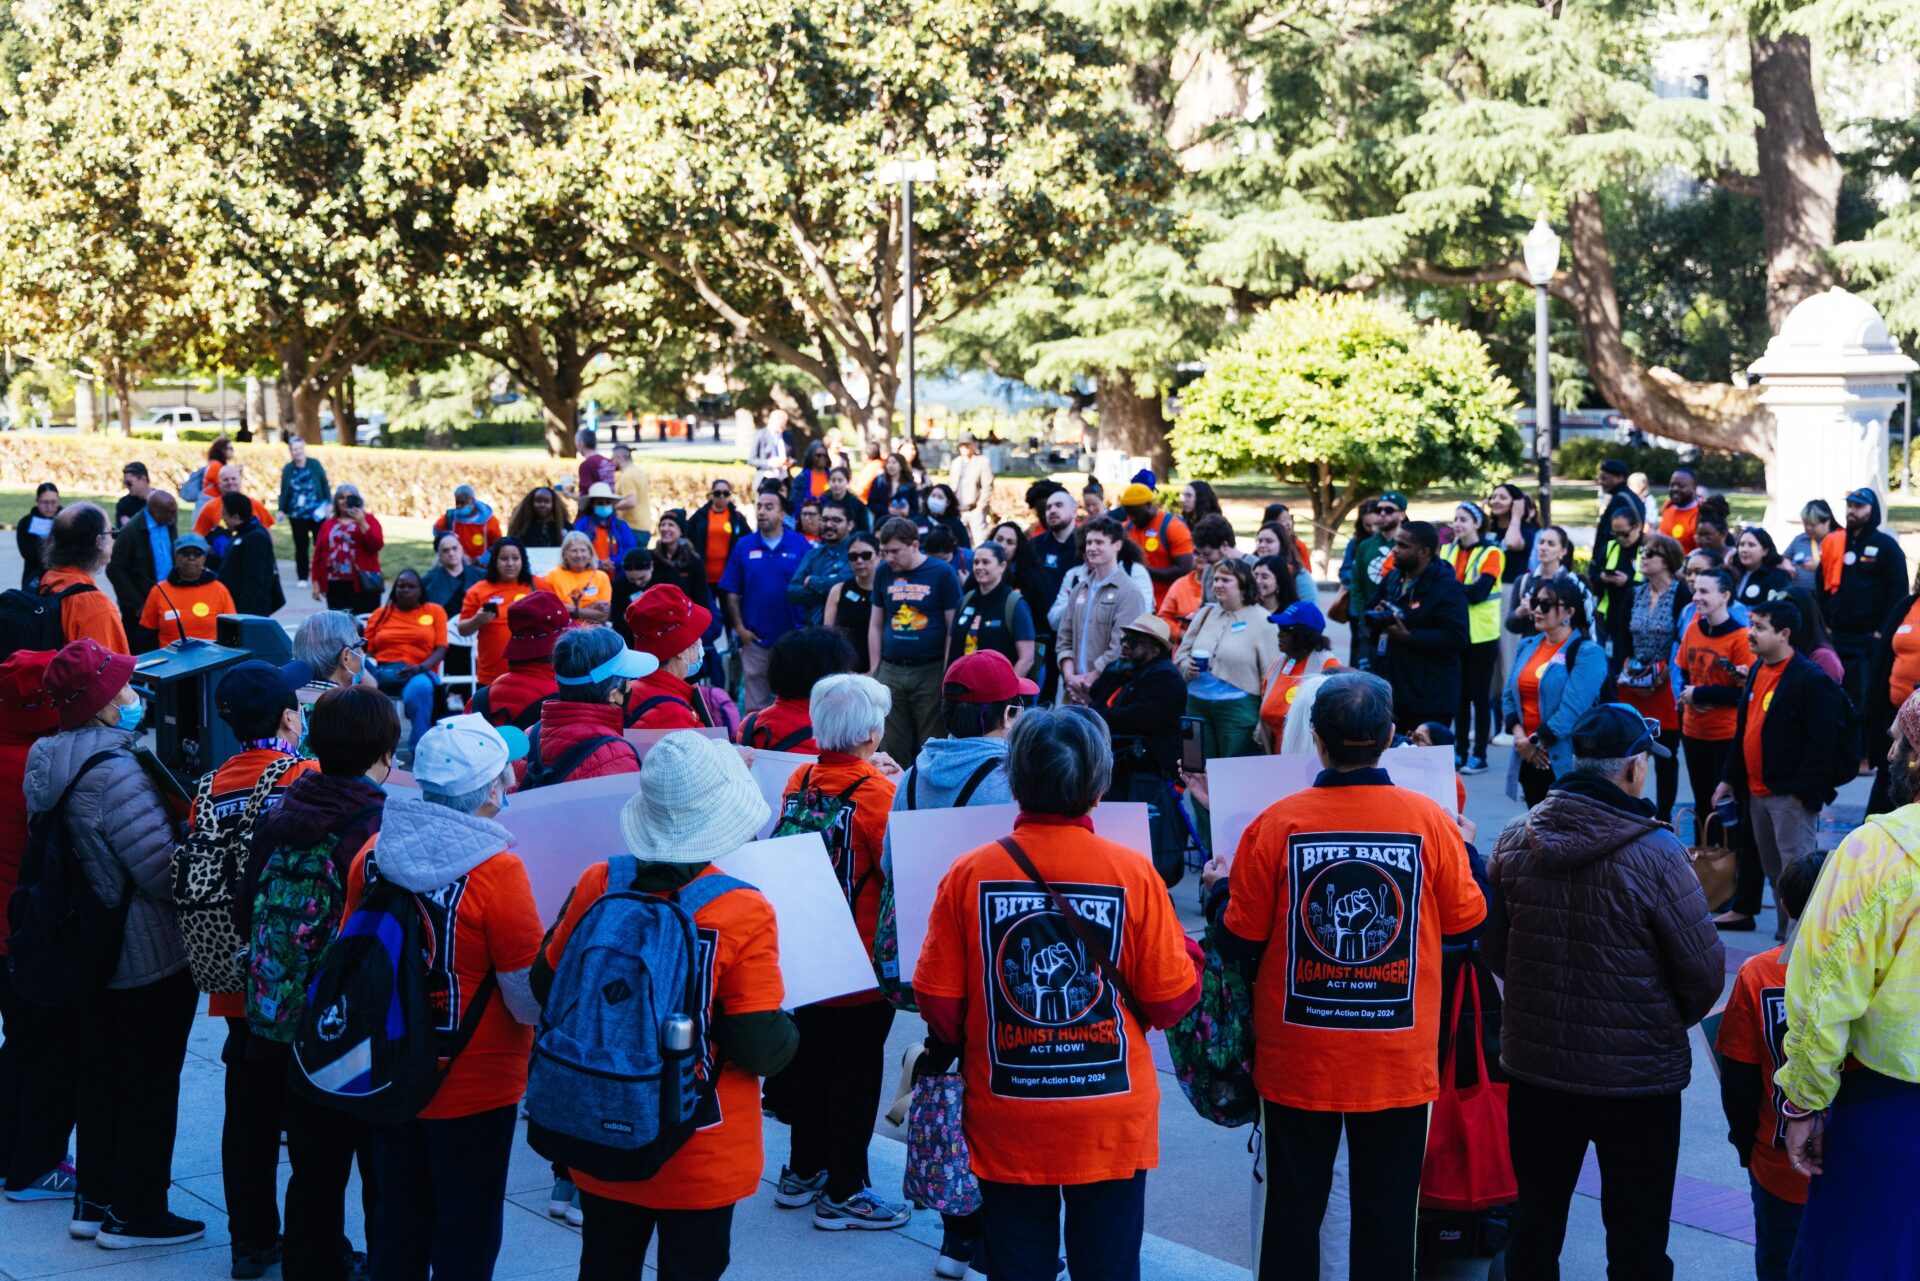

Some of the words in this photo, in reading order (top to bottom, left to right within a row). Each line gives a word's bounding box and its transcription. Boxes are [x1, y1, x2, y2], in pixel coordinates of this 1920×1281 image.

[1303, 847, 1350, 872] BITE
[1355, 847, 1412, 873] BACK
[995, 897, 1045, 924] BITE
[1296, 959, 1352, 984] AGAINST
[1354, 957, 1409, 985] HUNGER!
[1327, 980, 1346, 989] ACT
[1350, 981, 1377, 989] NOW!
[1306, 1006, 1333, 1016] Hunger
[1334, 1009, 1359, 1017] Action
[1361, 1010, 1376, 1018] Day
[1377, 1009, 1395, 1017] 2024
[997, 1021, 1055, 1052] AGAINST
[1057, 1017, 1119, 1045] HUNGER!
[1030, 1045, 1052, 1053] ACT
[1055, 1043, 1085, 1052] NOW!
[1011, 1076, 1039, 1086] Hunger
[1041, 1075, 1068, 1084] Action
[1070, 1075, 1086, 1084] Day
[1087, 1072, 1106, 1082] 2024
[603, 1122, 632, 1132] adidas
